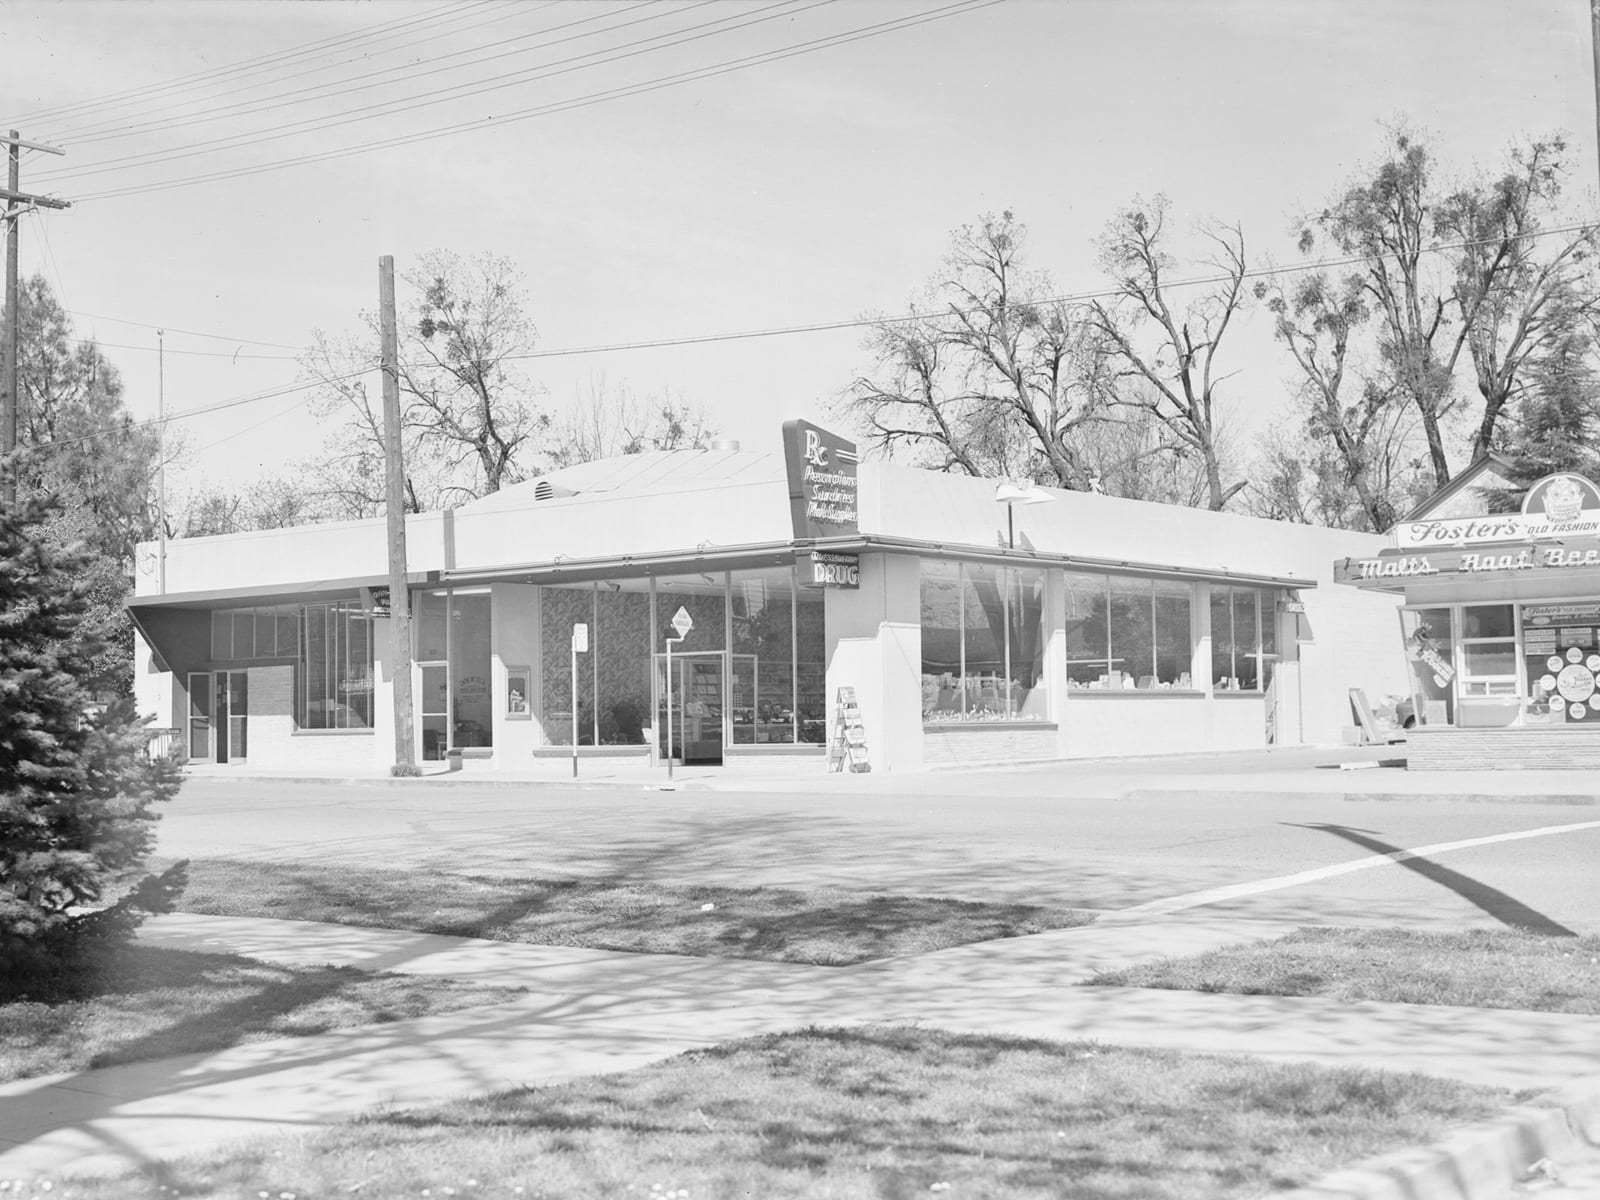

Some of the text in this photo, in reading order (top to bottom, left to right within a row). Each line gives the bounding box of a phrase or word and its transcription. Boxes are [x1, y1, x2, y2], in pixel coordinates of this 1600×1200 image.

[804, 466, 857, 487] Prescriptions
[811, 484, 855, 504] Sundries
[1410, 518, 1599, 542] Foster's OLD FASHION
[814, 563, 860, 585] DRUG
[1358, 556, 1440, 578] Malts
[1544, 548, 1600, 567] Bee
